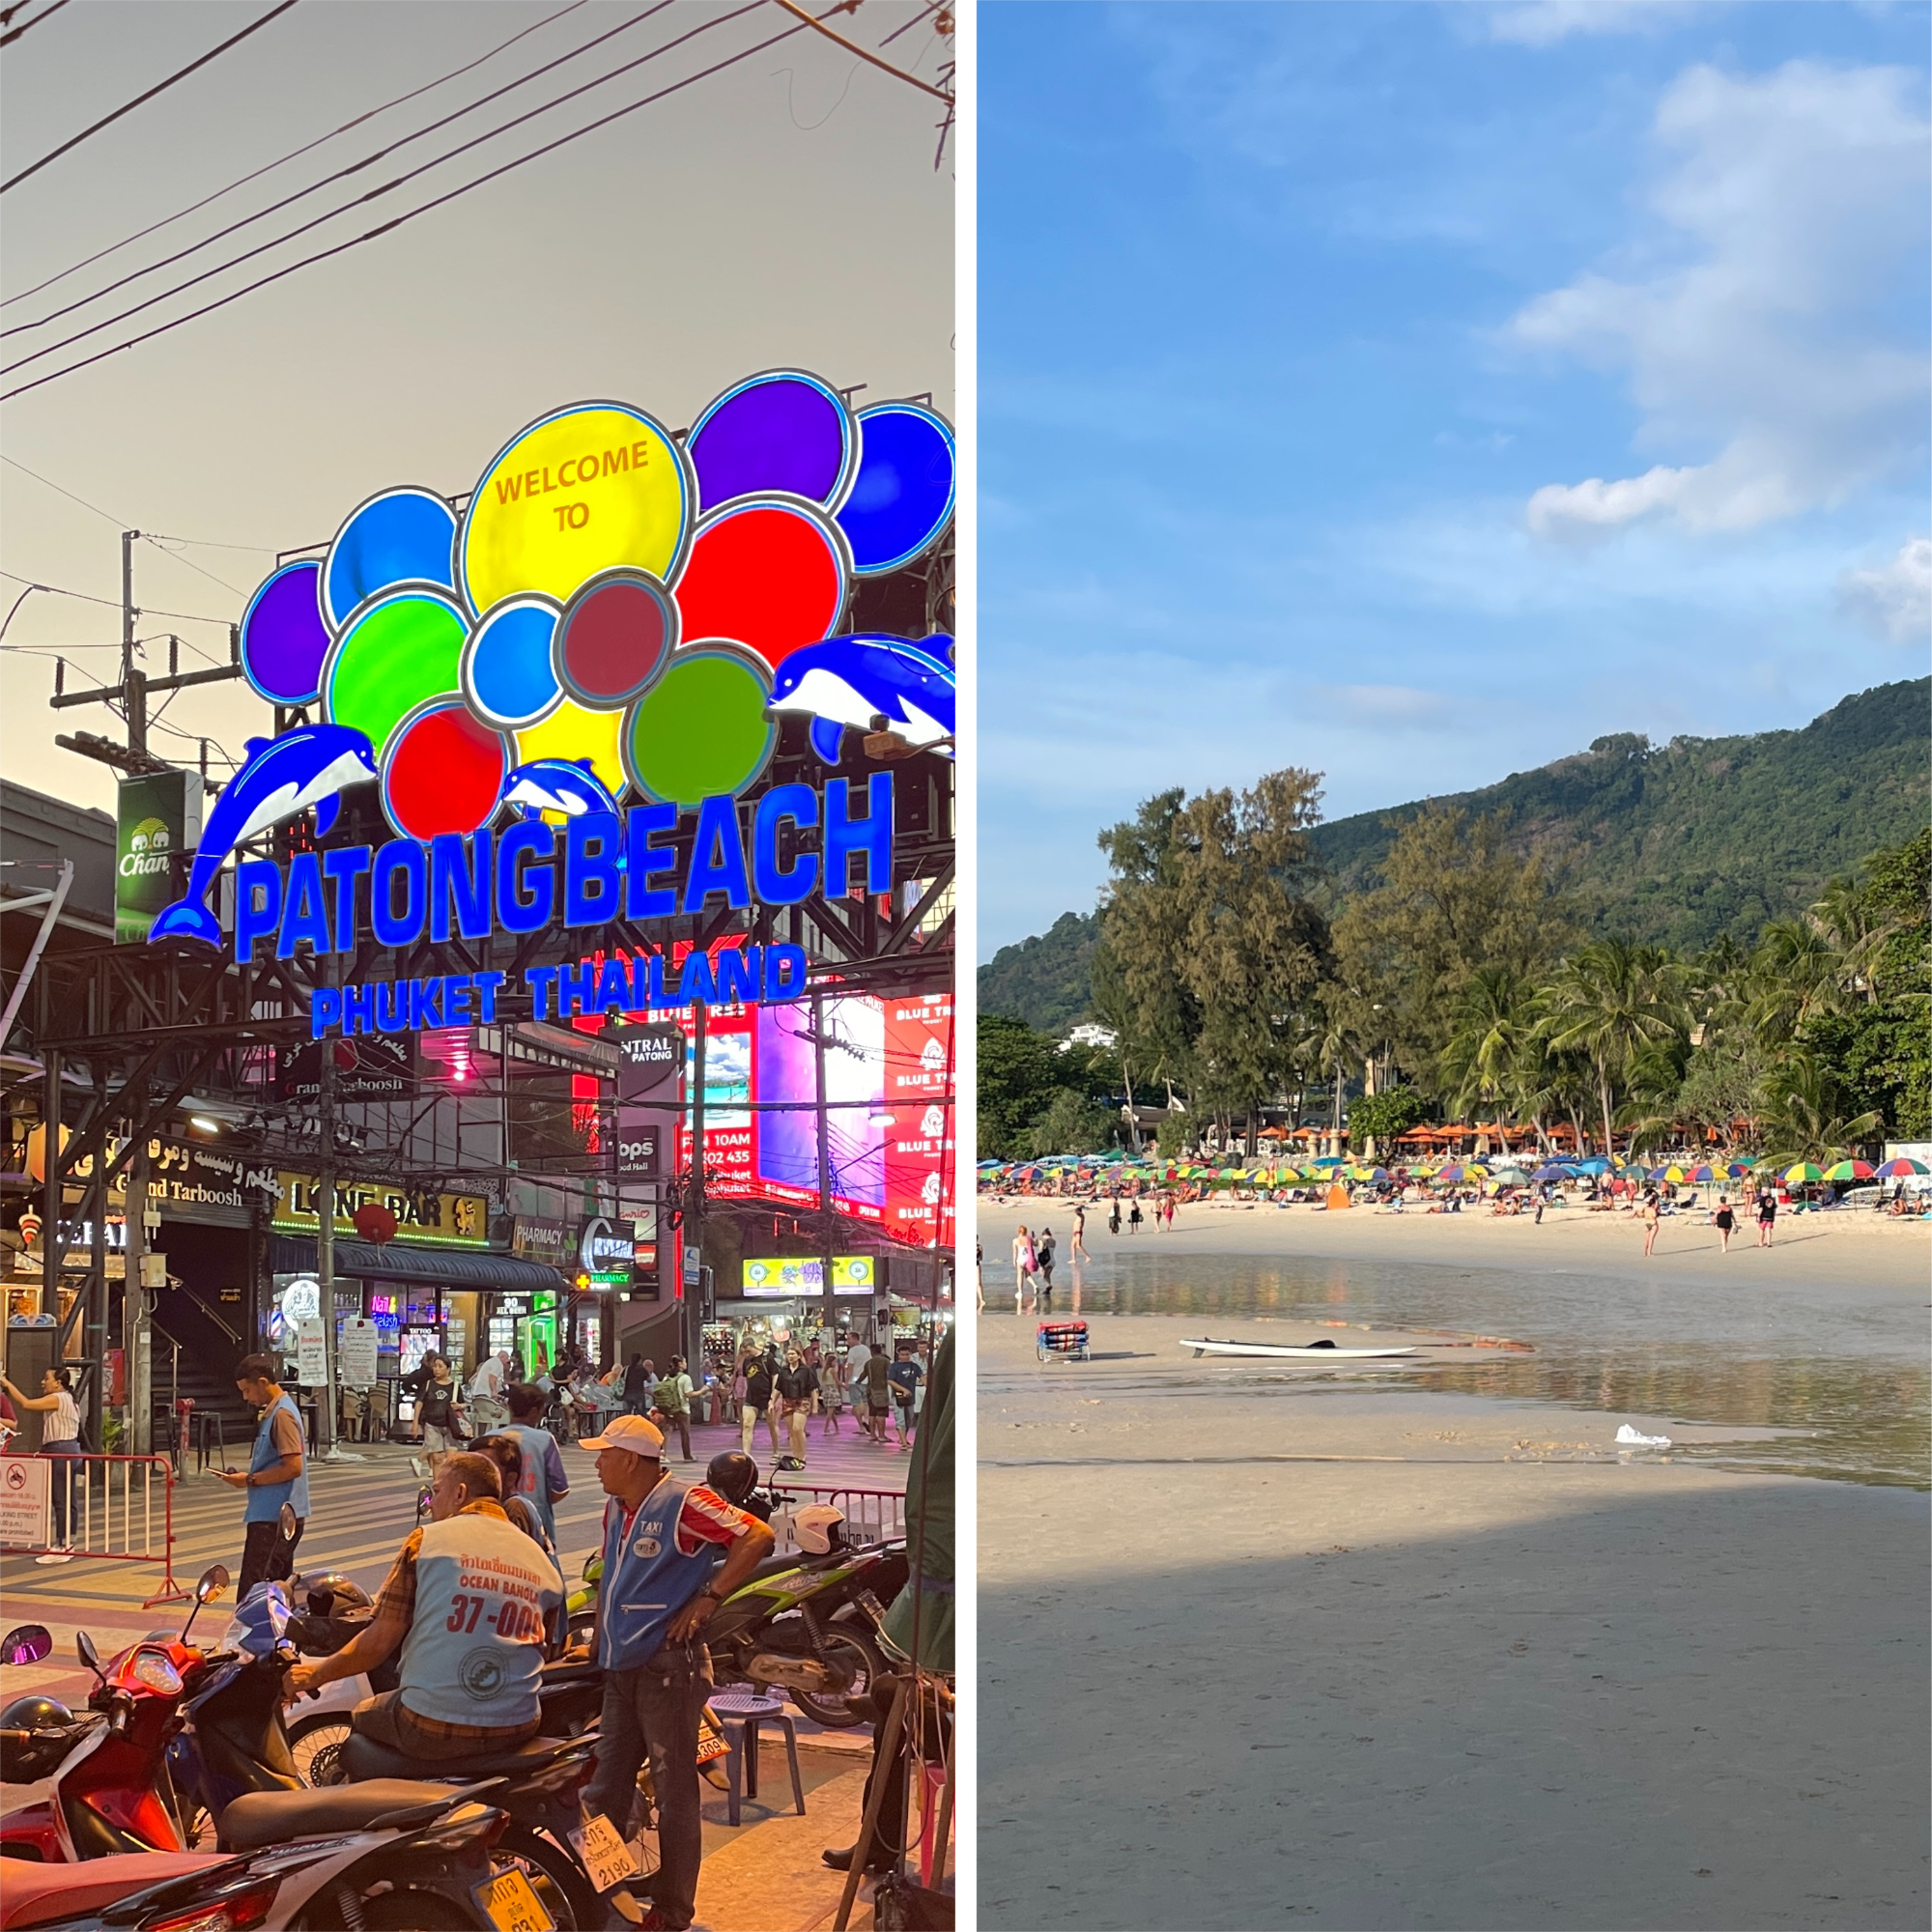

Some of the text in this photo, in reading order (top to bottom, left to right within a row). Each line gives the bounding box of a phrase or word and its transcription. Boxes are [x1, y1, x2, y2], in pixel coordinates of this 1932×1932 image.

[496, 440, 650, 505] WELCOME
[554, 500, 590, 532] TO
[311, 969, 505, 1039] PHUKET
[526, 943, 808, 1021] THAILAND
[648, 1003, 746, 1023] BLUE REE
[896, 1009, 929, 1020] BLUE
[620, 1037, 673, 1054] NTRAL
[631, 1050, 673, 1063] PATONG
[896, 1074, 930, 1087] BLUE
[285, 1082, 322, 1094] Gran
[715, 1133, 751, 1147] 10AM
[897, 1140, 931, 1152] BLUE
[726, 1151, 750, 1163] 435
[633, 1161, 648, 1171] Hall
[170, 1180, 243, 1208] Tarboosh
[384, 1193, 441, 1228] BAR
[898, 1208, 932, 1219] BLUE
[517, 1225, 563, 1246] PHARMACY
[590, 1273, 630, 1284] PHARMACY
[640, 1520, 663, 1533] TAXI
[460, 1575, 498, 1592] OCEAN
[598, 1857, 631, 1888] 2190
